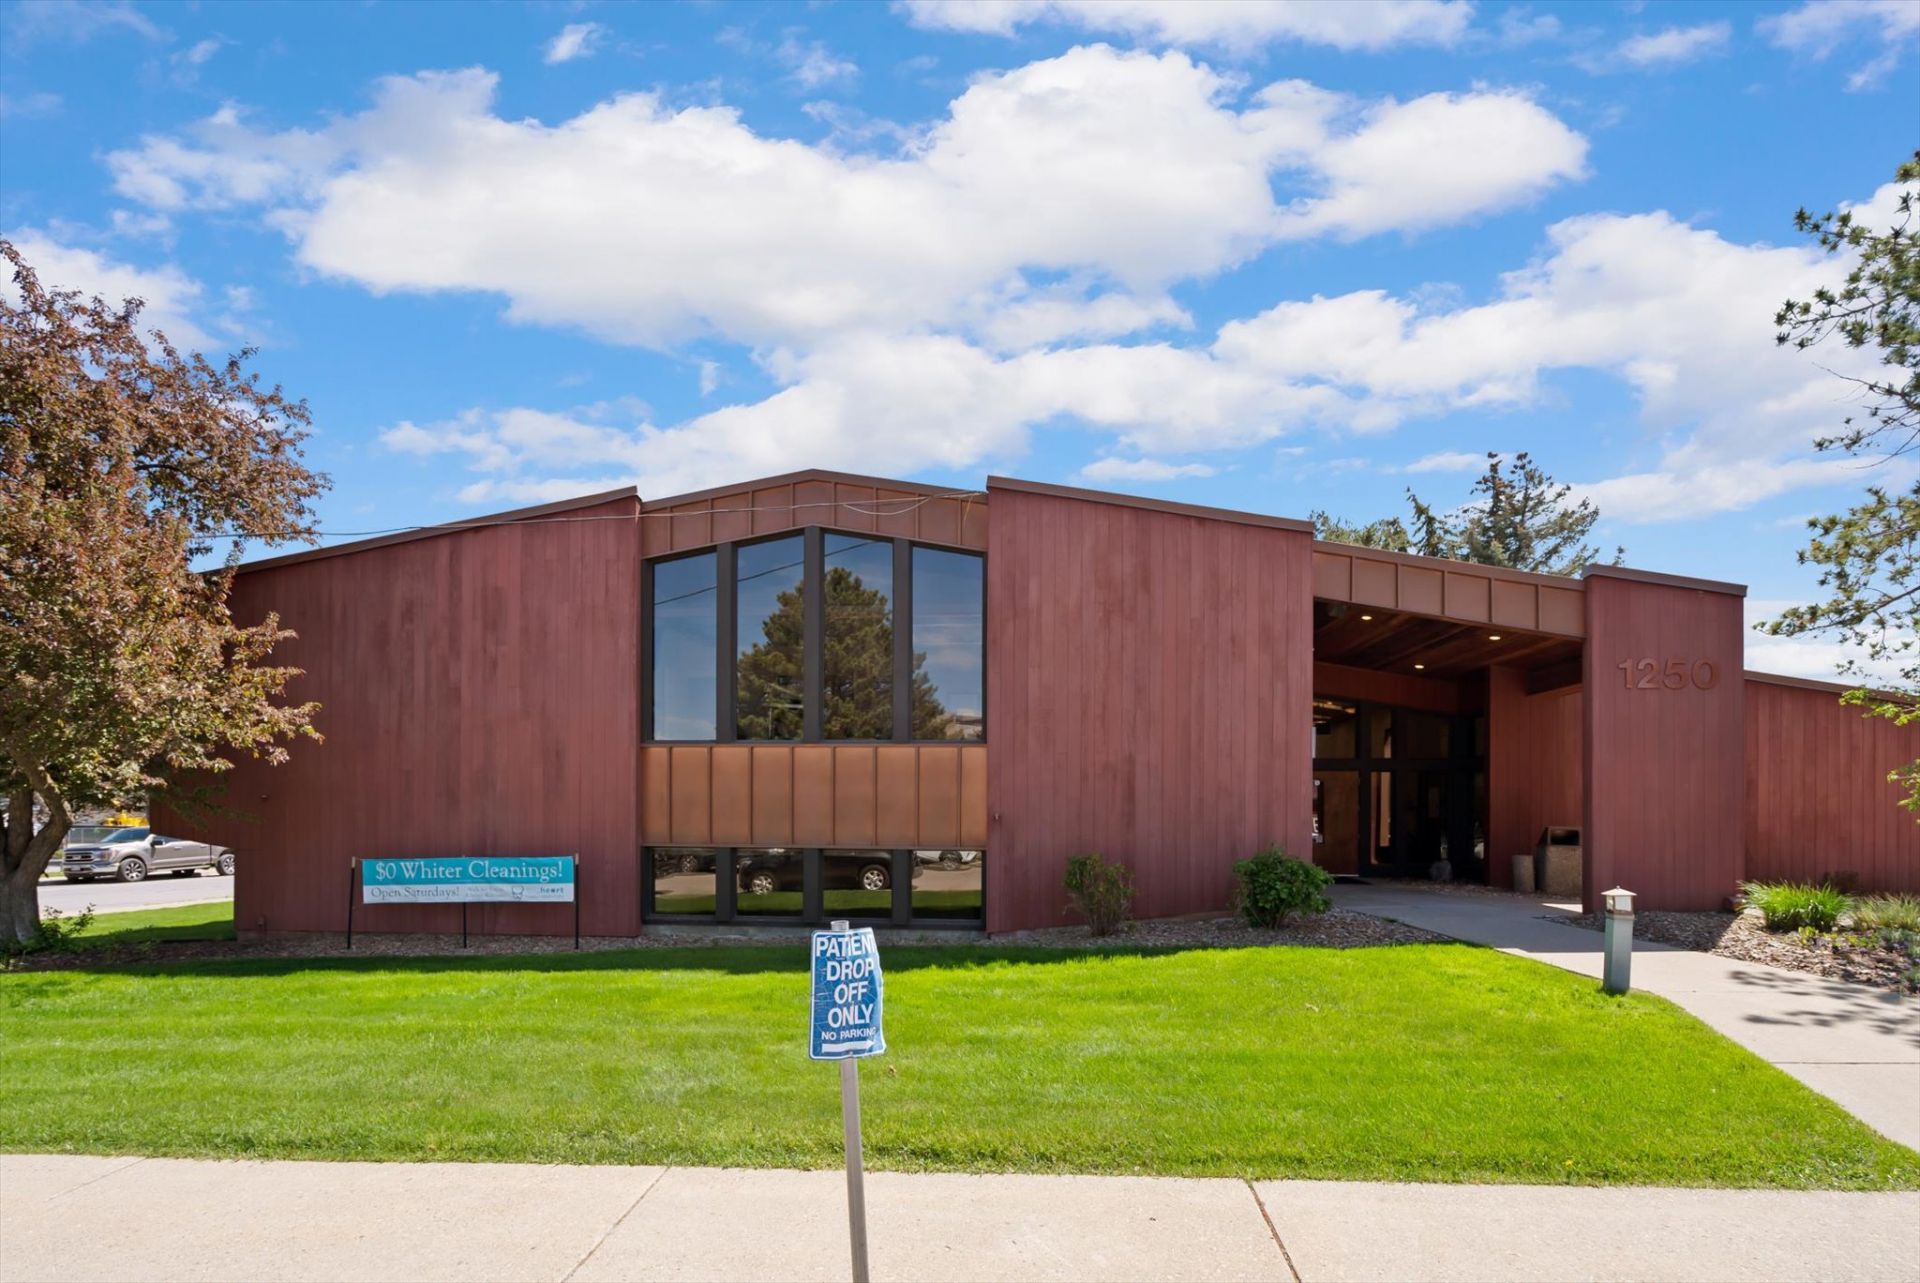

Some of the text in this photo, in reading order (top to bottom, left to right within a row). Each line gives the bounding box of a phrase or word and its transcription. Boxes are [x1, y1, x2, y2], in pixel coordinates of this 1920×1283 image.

[1617, 657, 1720, 691] 1250
[375, 860, 563, 883] $0 Whiter Cleanings!
[371, 887, 401, 900] Open
[404, 886, 460, 900] Saturdays!
[826, 959, 874, 981] DROP
[834, 981, 868, 1004] OFF
[827, 1003, 874, 1028] ONLY
[822, 1031, 837, 1040] NO
